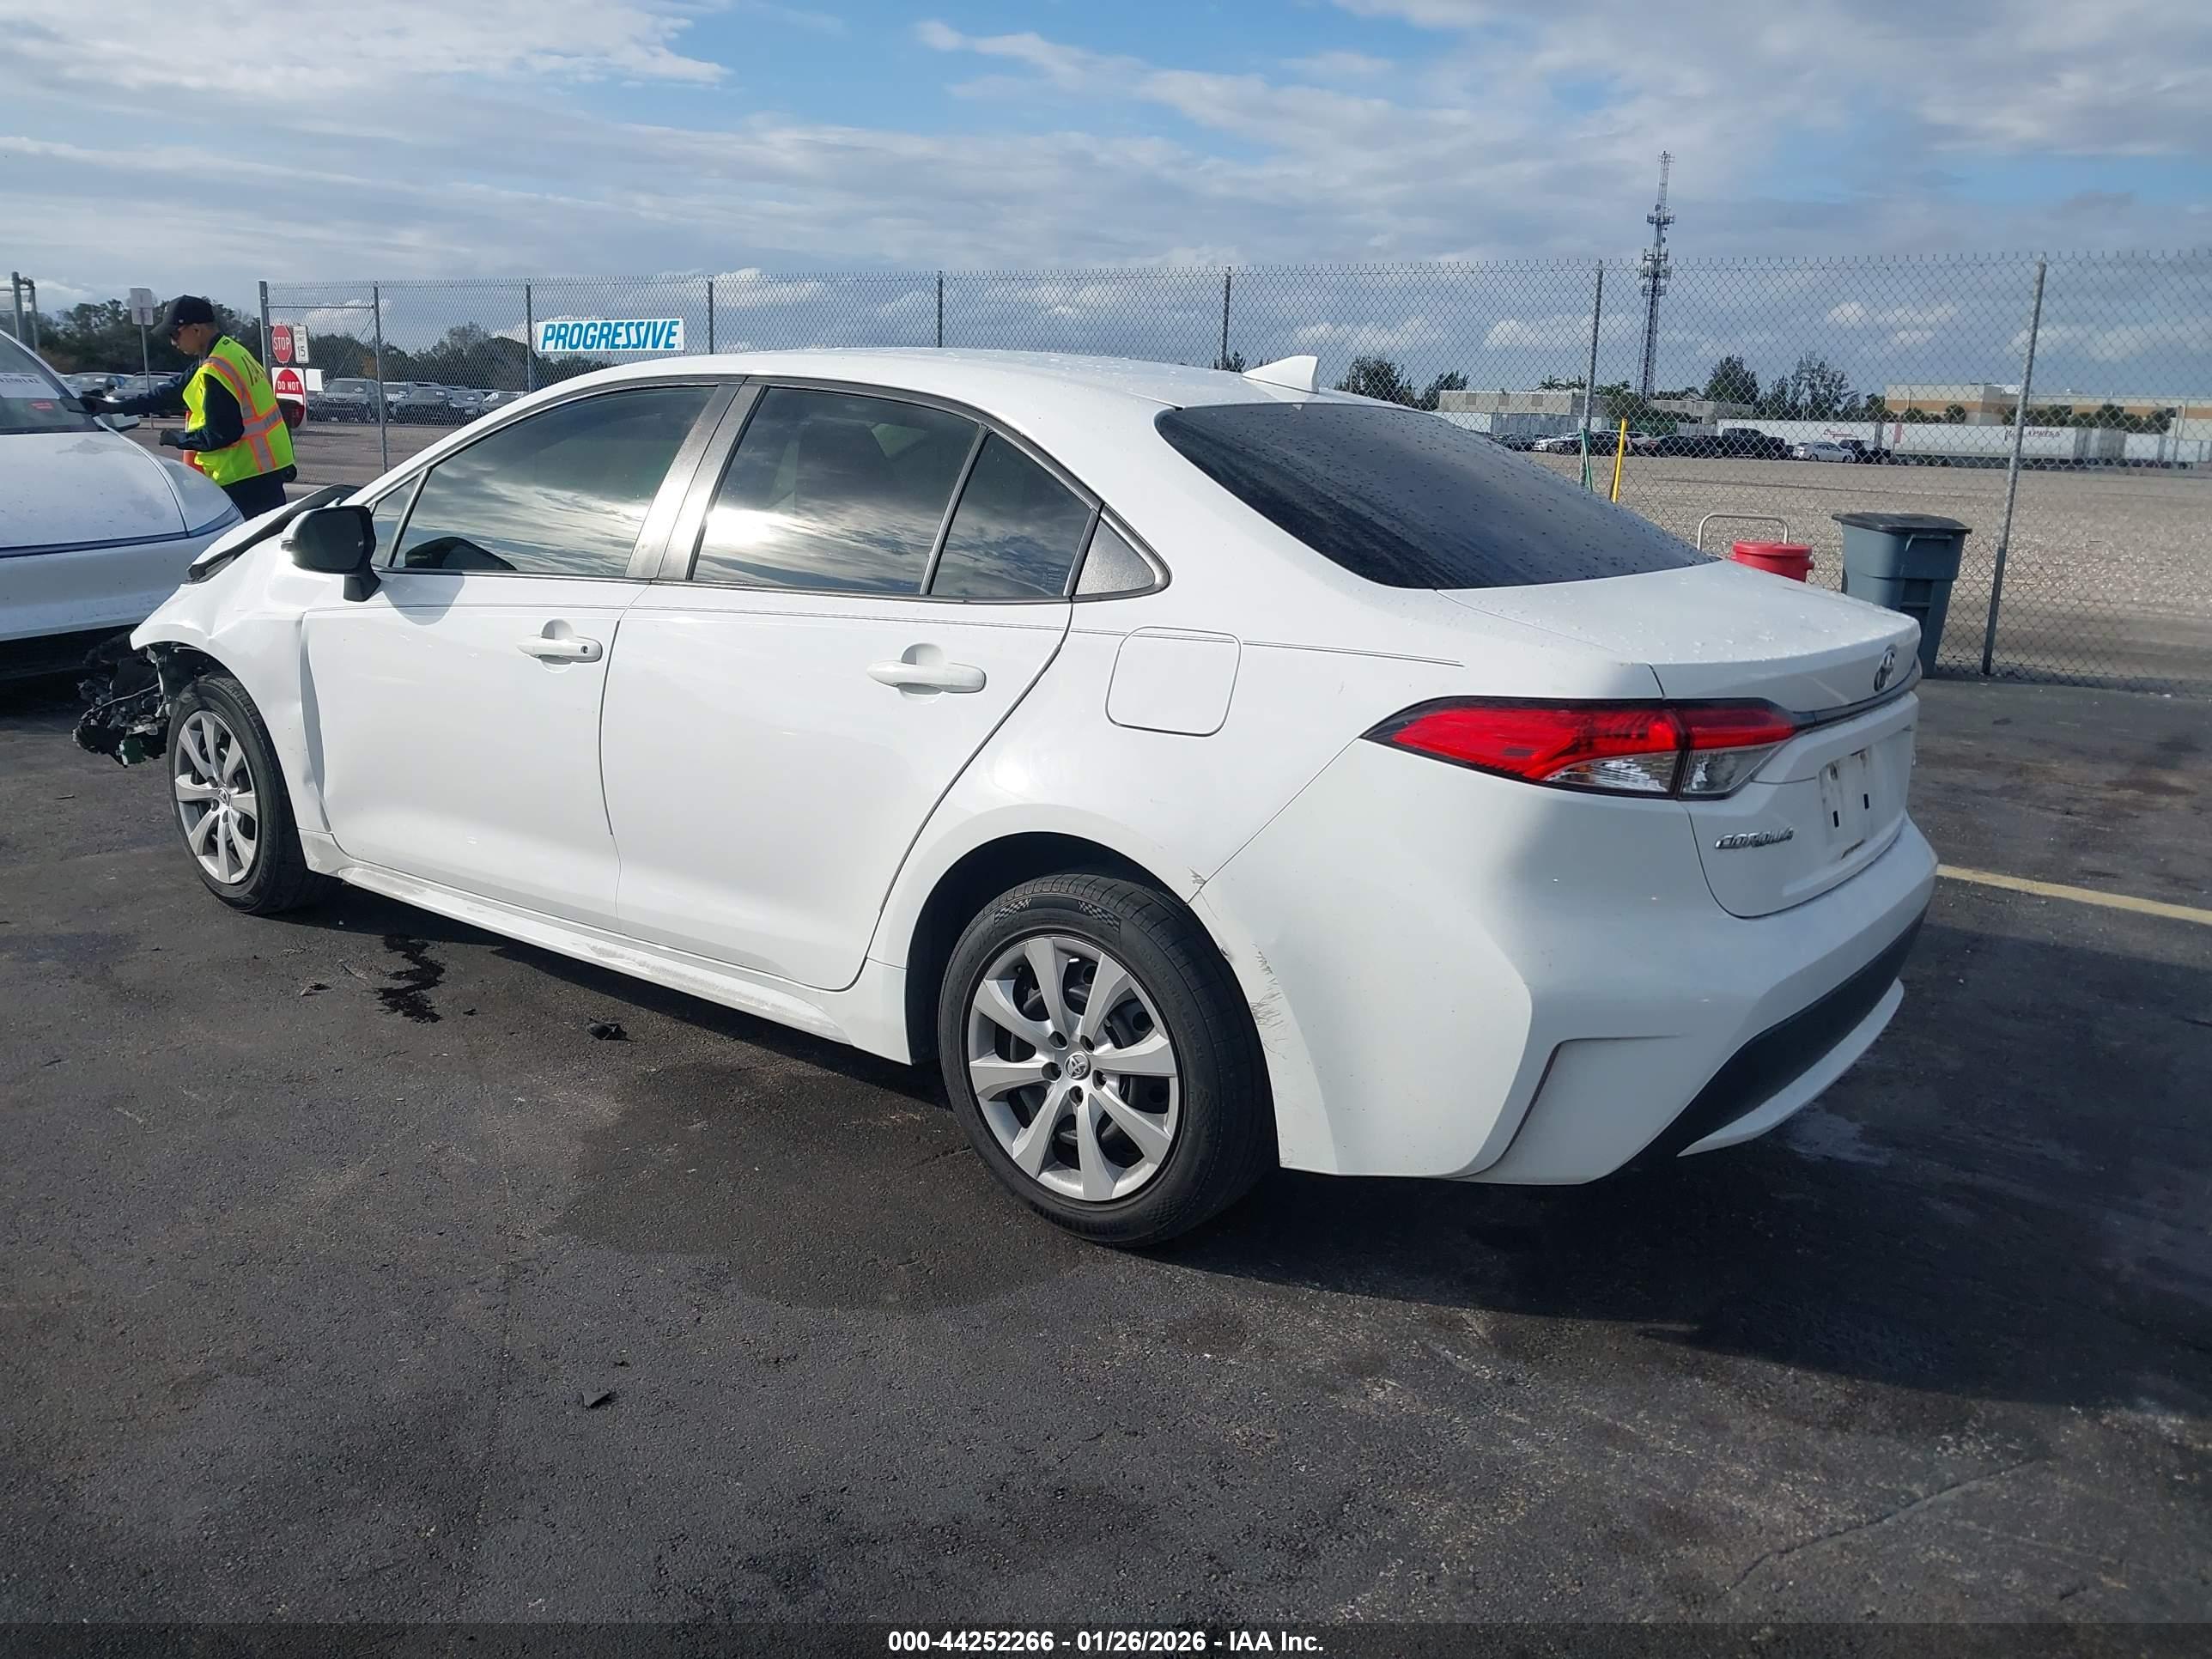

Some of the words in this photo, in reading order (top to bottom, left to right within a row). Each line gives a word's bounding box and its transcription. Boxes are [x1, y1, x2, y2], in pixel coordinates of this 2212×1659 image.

[541, 320, 680, 350] PROGRESSIVE
[274, 337, 291, 351] STOP
[297, 345, 306, 357] 15
[277, 381, 286, 391] DO
[287, 381, 300, 392] NOT
[1715, 827, 1794, 849] COROLLA
